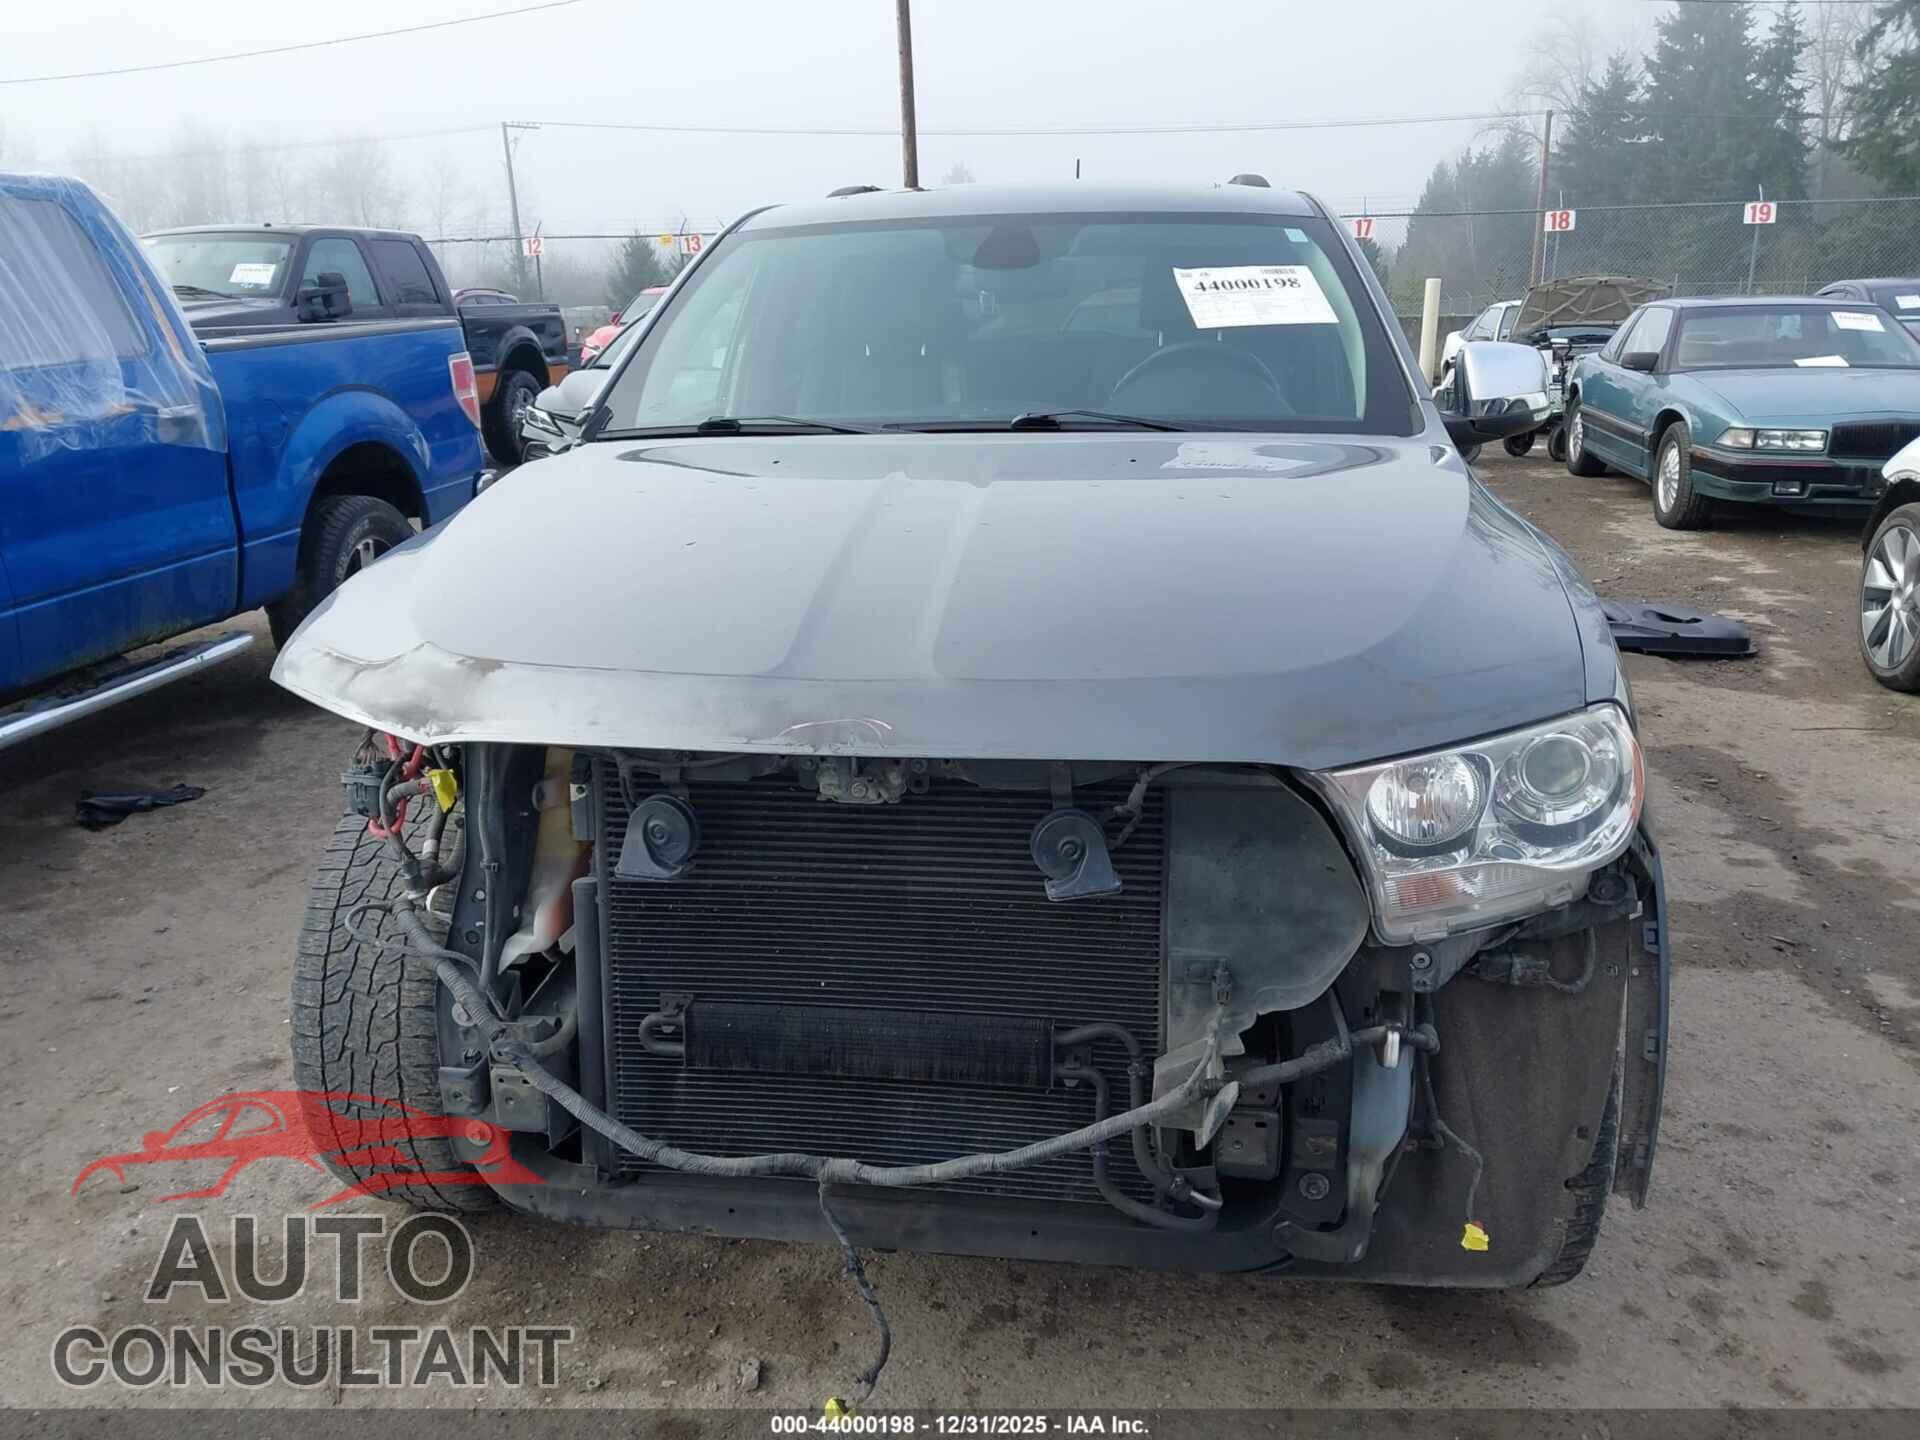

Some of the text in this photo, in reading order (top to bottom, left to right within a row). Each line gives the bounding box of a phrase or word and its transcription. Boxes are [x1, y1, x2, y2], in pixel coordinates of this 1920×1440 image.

[1549, 211, 1570, 230] 18
[1750, 203, 1771, 222] 19
[1355, 219, 1373, 237] 17
[527, 238, 542, 255] 12
[684, 235, 701, 252] 13
[1194, 277, 1301, 292] 44000198
